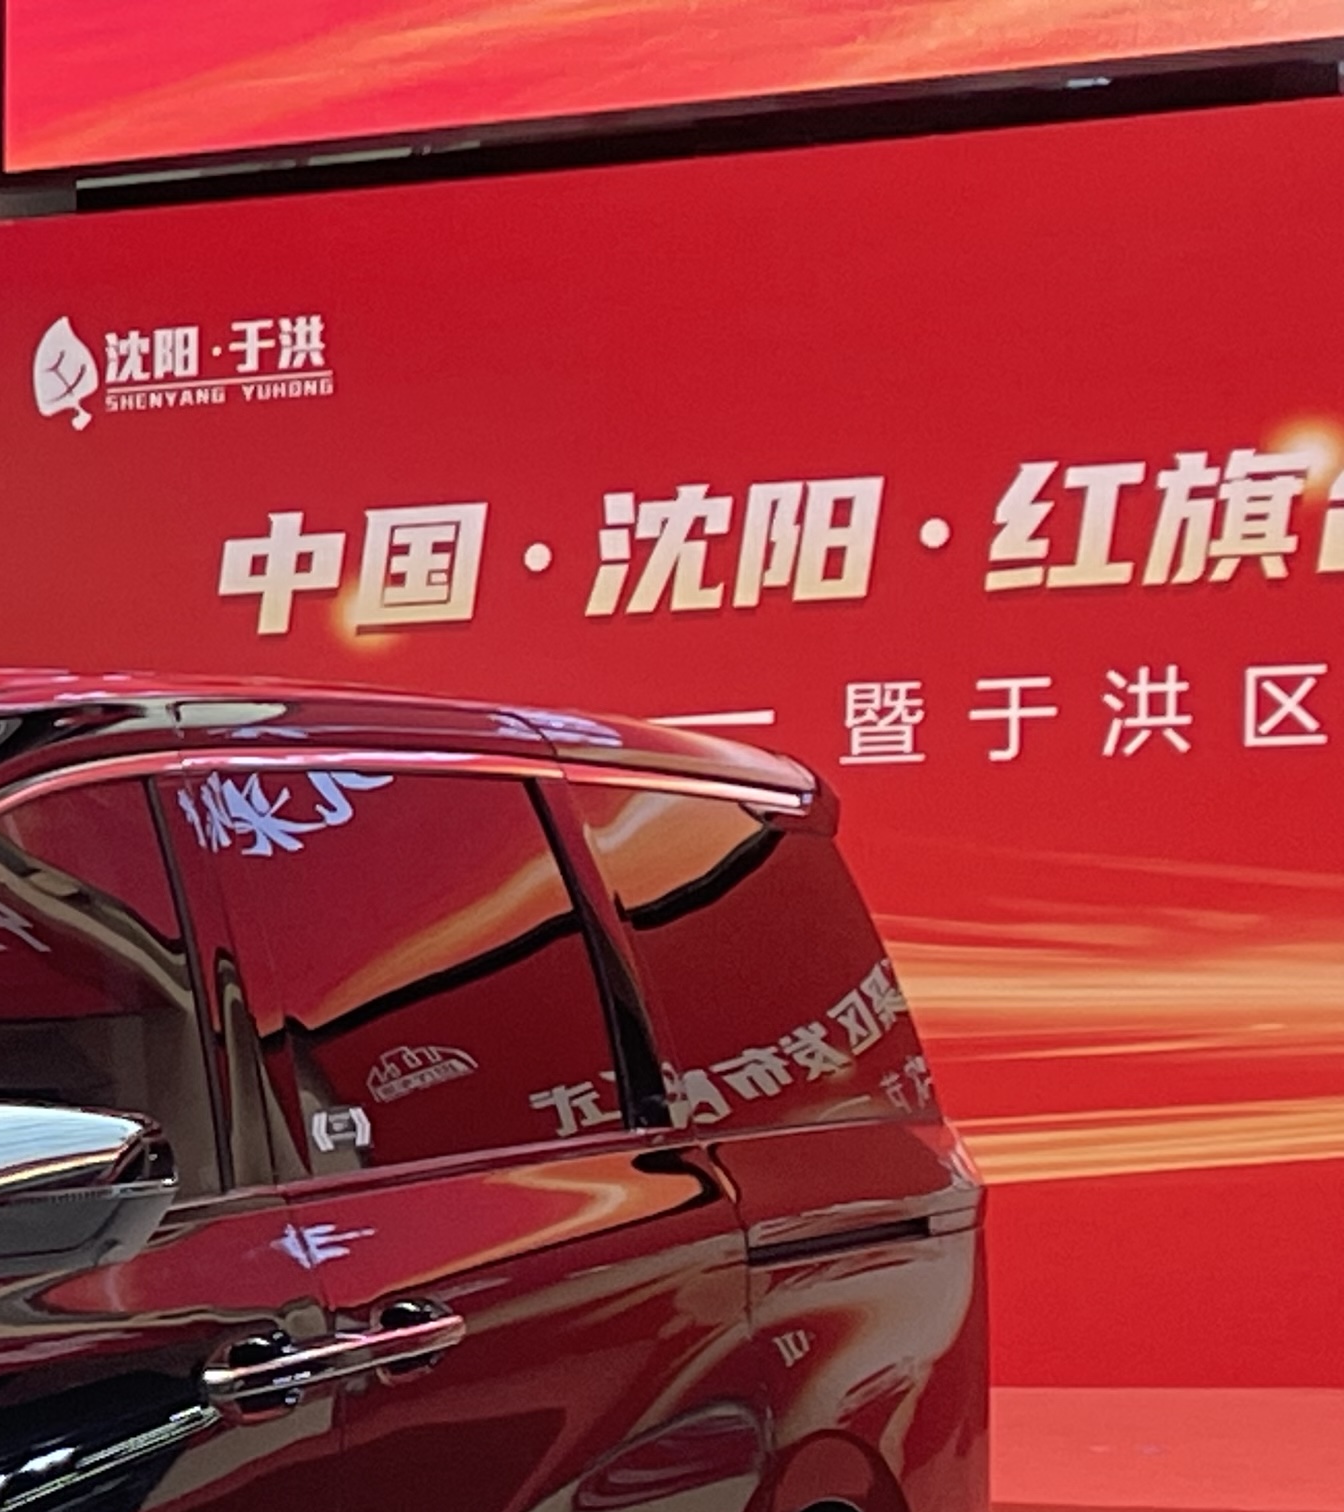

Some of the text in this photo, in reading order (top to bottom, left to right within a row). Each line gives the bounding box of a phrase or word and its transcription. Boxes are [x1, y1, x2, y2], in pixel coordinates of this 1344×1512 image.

[105, 314, 325, 383] 沈阳·于洪
[105, 376, 334, 412] SHENYANG YUHONG
